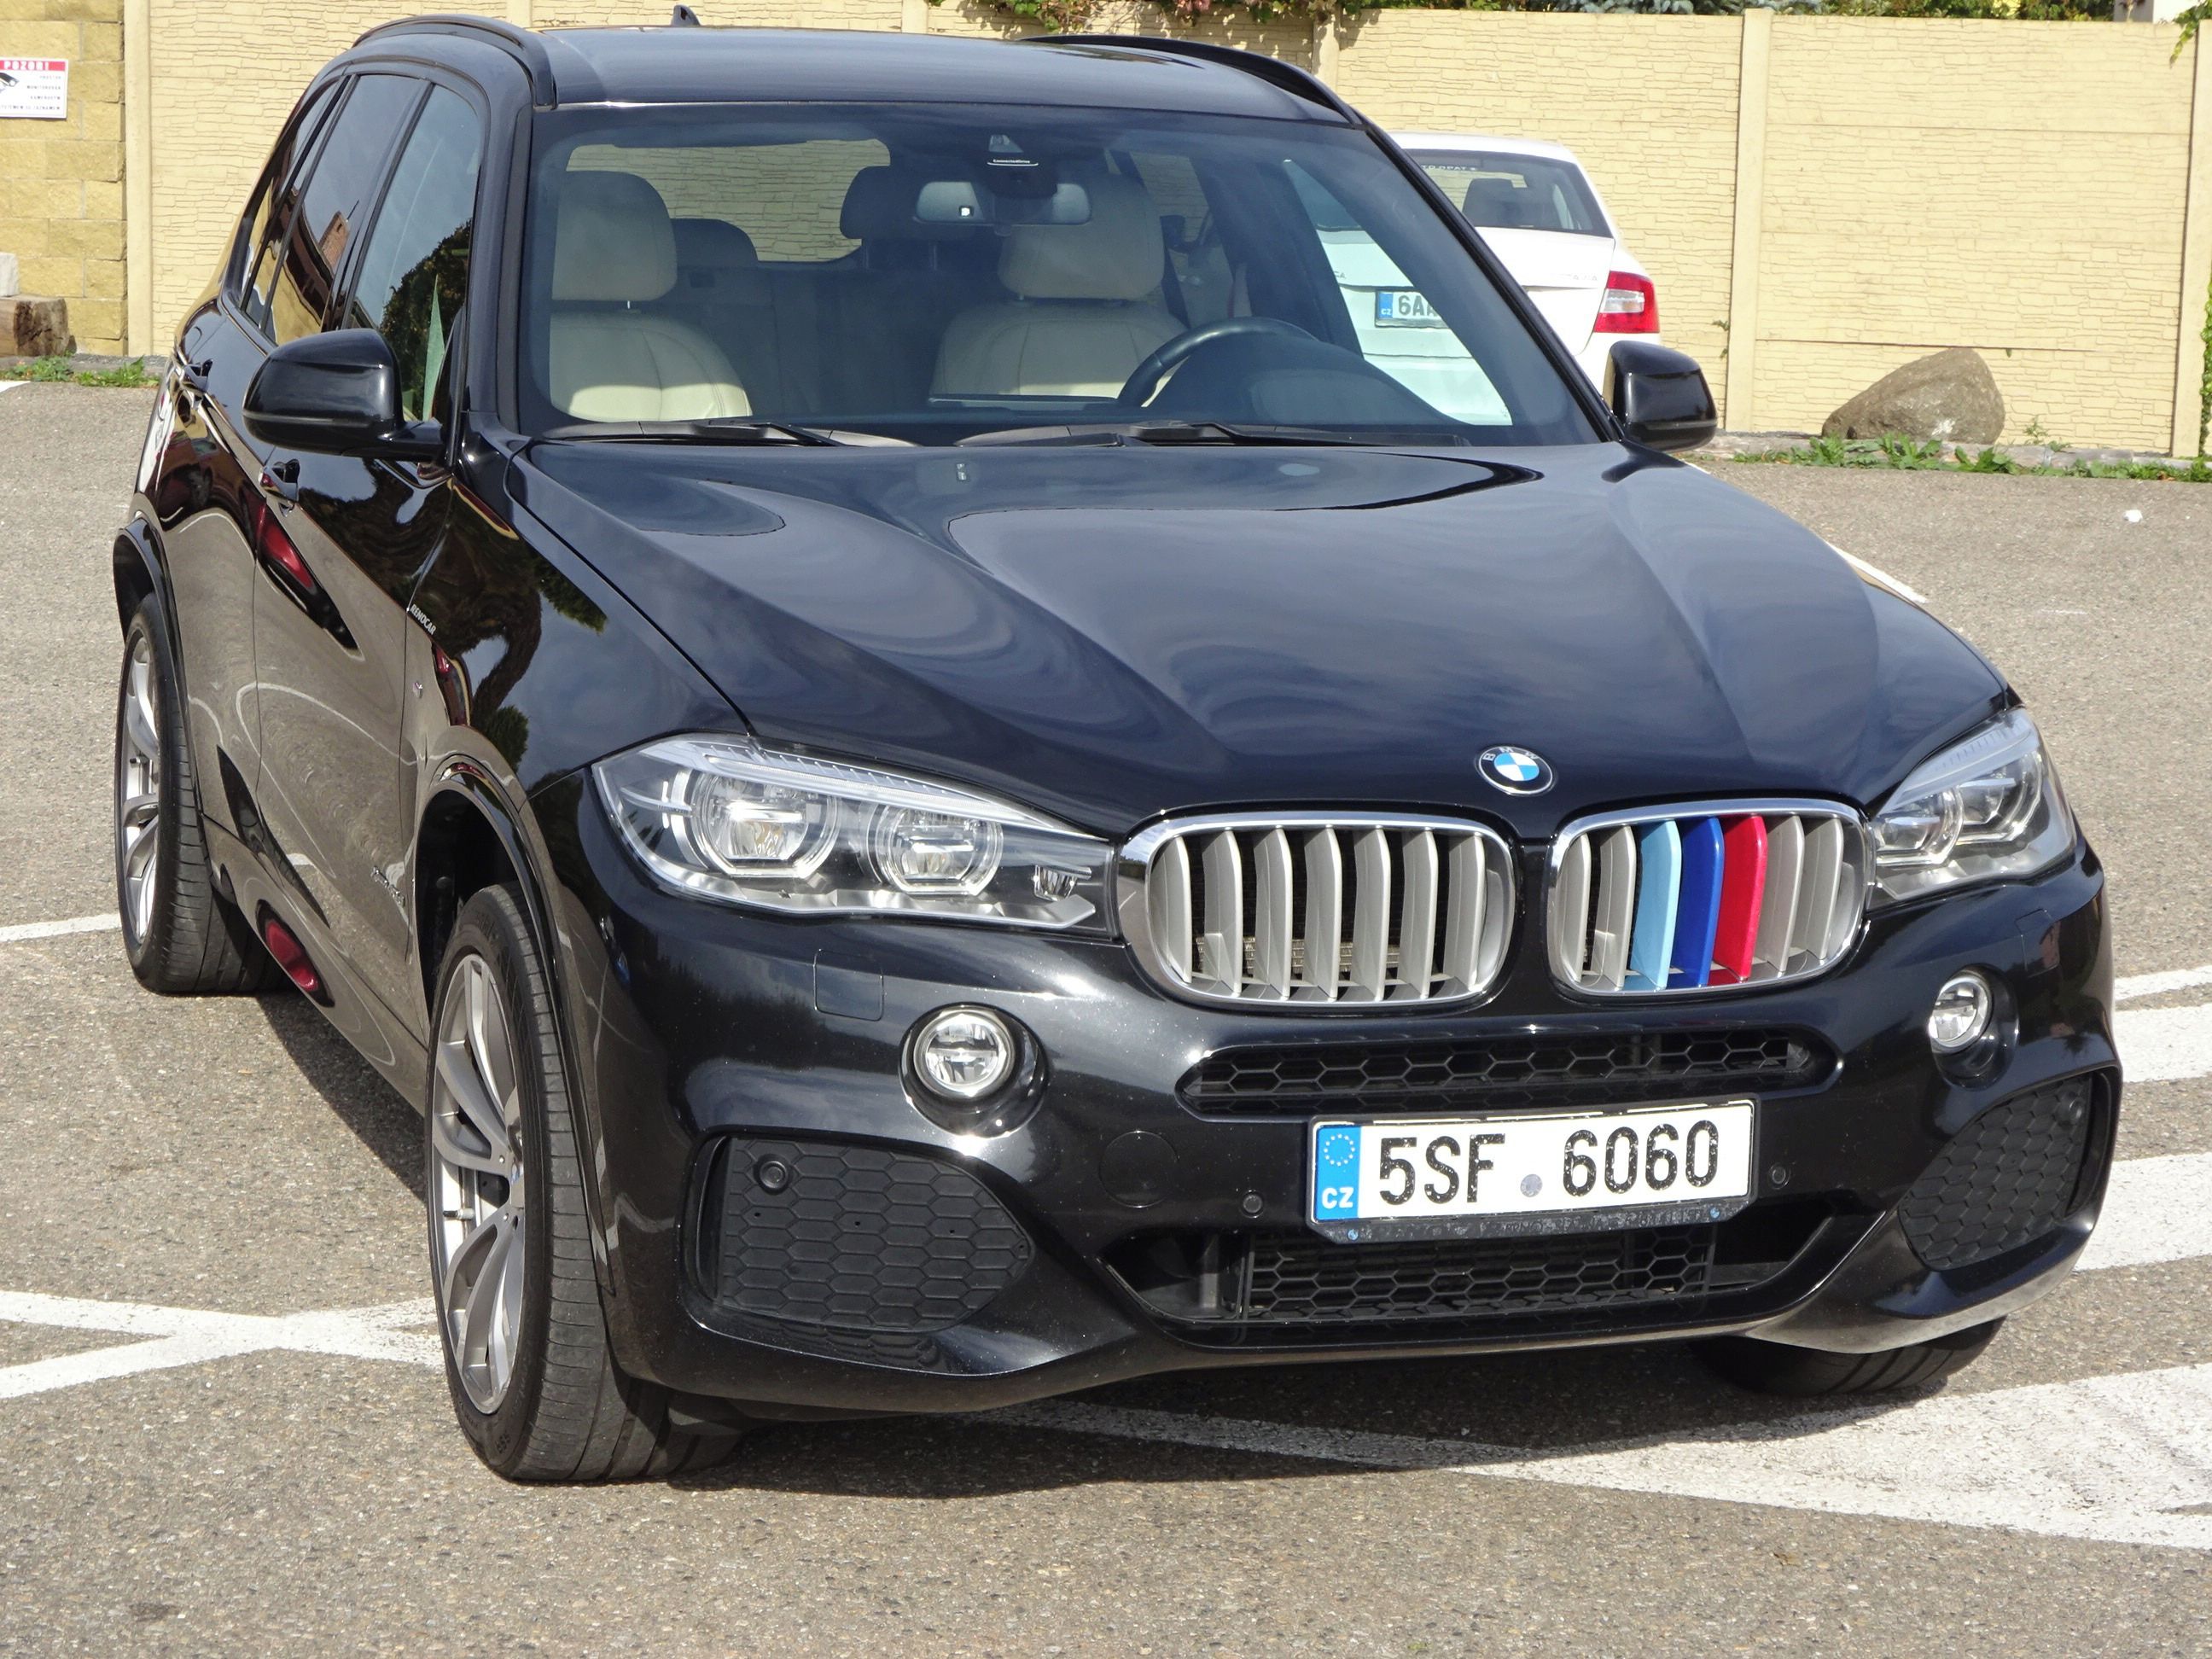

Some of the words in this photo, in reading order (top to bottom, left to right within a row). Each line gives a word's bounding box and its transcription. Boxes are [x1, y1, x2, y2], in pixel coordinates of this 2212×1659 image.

[3, 61, 49, 70] POZOR!
[410, 604, 436, 635] RENOCAR
[1482, 746, 1540, 761] BMW
[1379, 1133, 1505, 1206] 5SF
[1563, 1120, 1720, 1196] 6060
[1322, 1185, 1354, 1209] CZ
